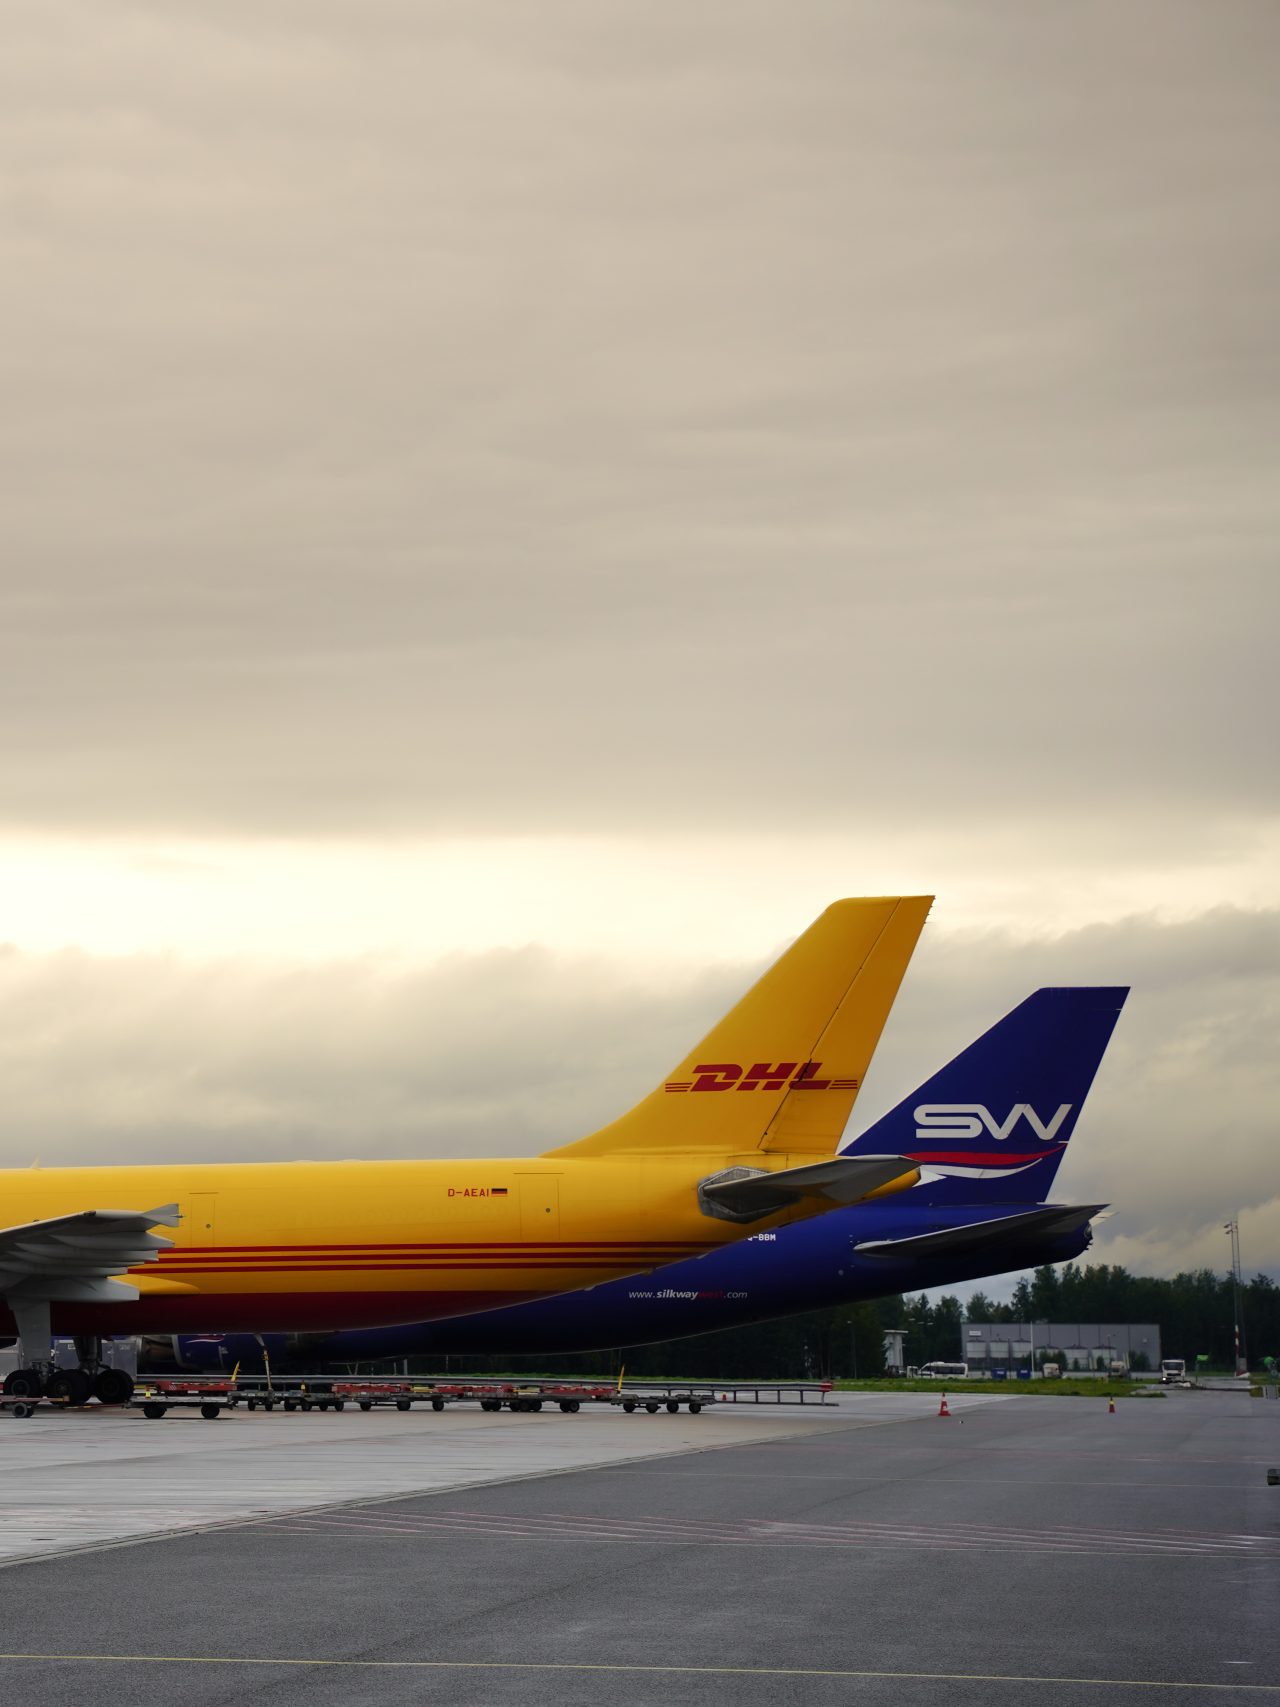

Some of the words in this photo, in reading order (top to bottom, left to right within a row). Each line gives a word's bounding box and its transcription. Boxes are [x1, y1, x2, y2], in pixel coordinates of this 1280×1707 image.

[690, 1063, 833, 1092] DHL
[913, 1104, 1073, 1140] SW
[447, 1188, 489, 1197] D-AEAI
[628, 1289, 748, 1300] www.silkway.com
